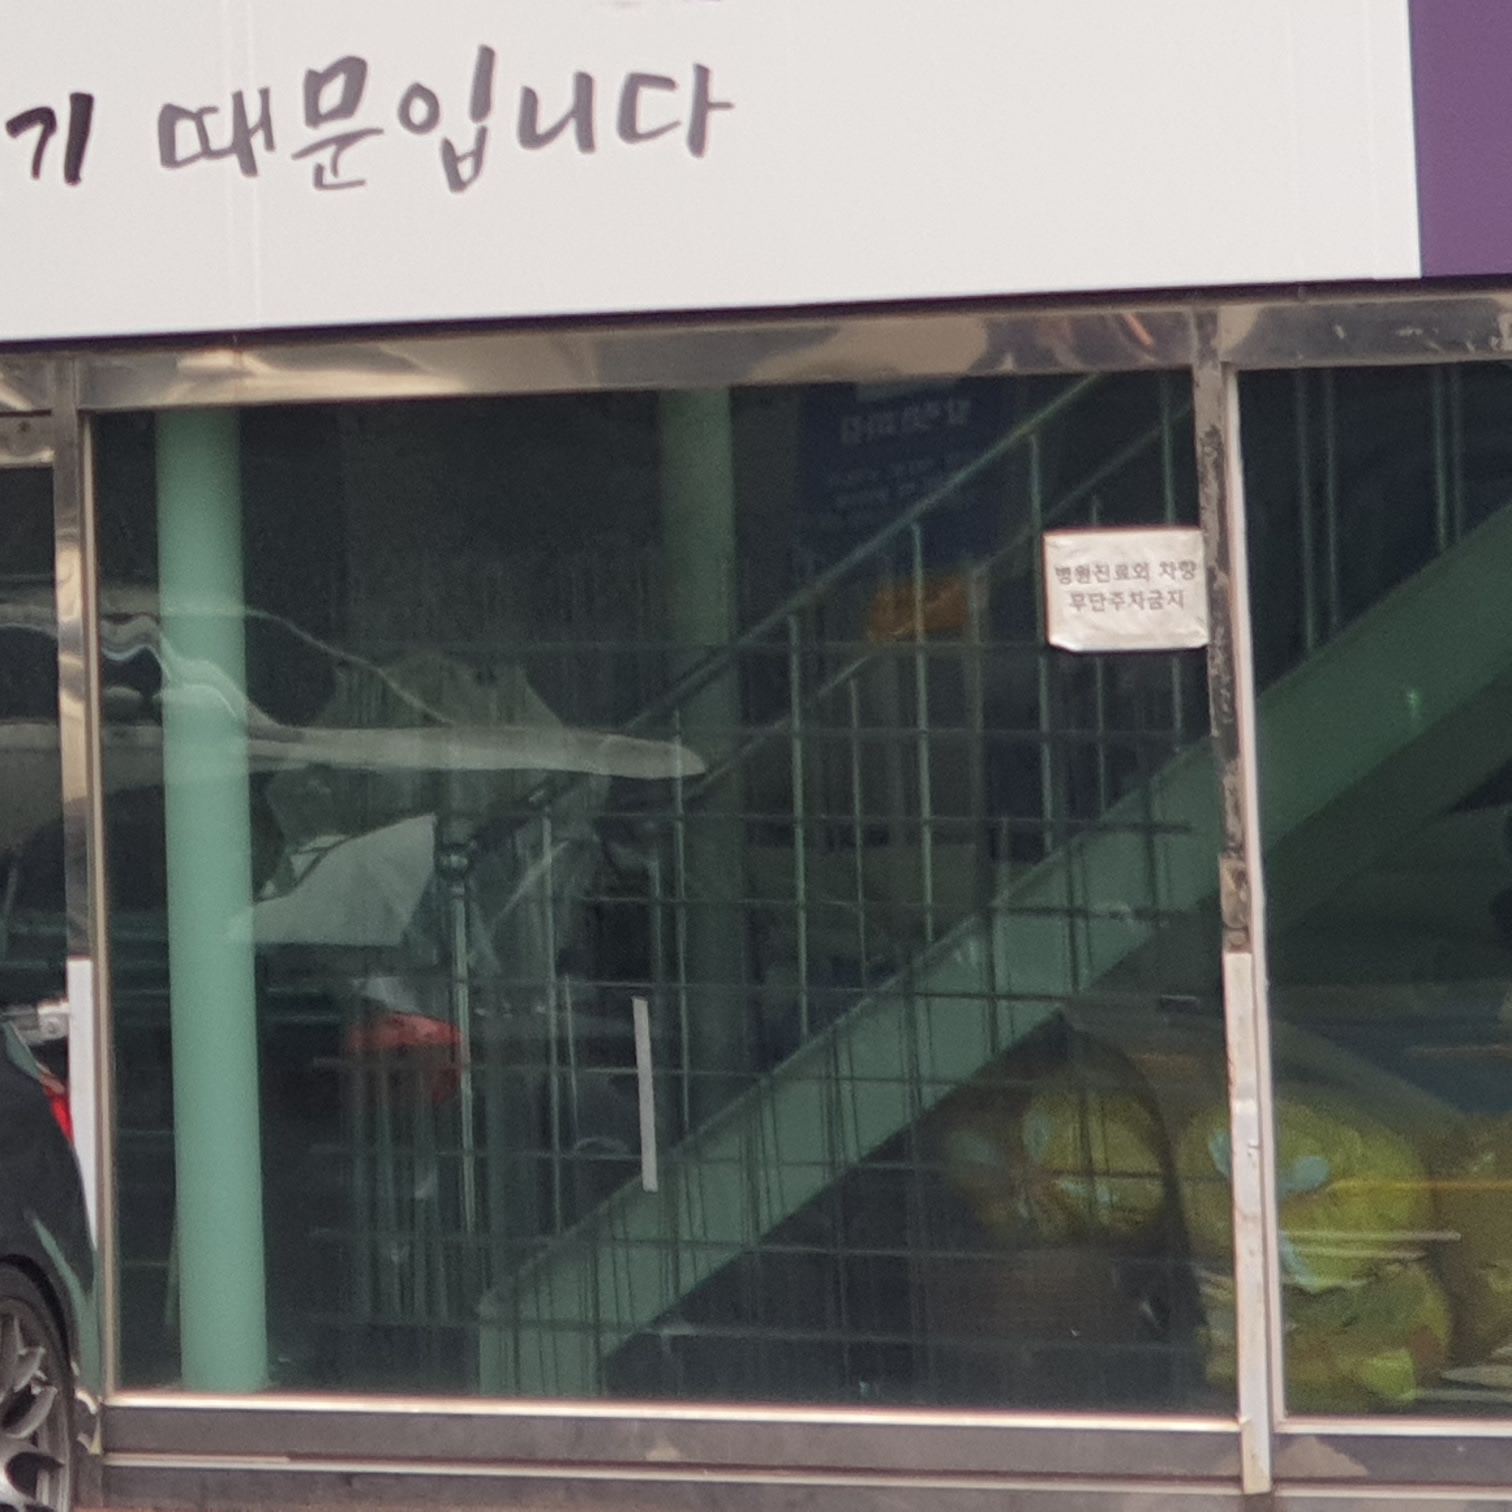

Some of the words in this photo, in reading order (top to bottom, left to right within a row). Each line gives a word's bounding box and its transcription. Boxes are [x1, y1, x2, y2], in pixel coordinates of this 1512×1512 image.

[156, 44, 734, 194] 때문입니다
[1055, 561, 1151, 585] 병원진료외
[1069, 590, 1185, 613] 무단주차금지
